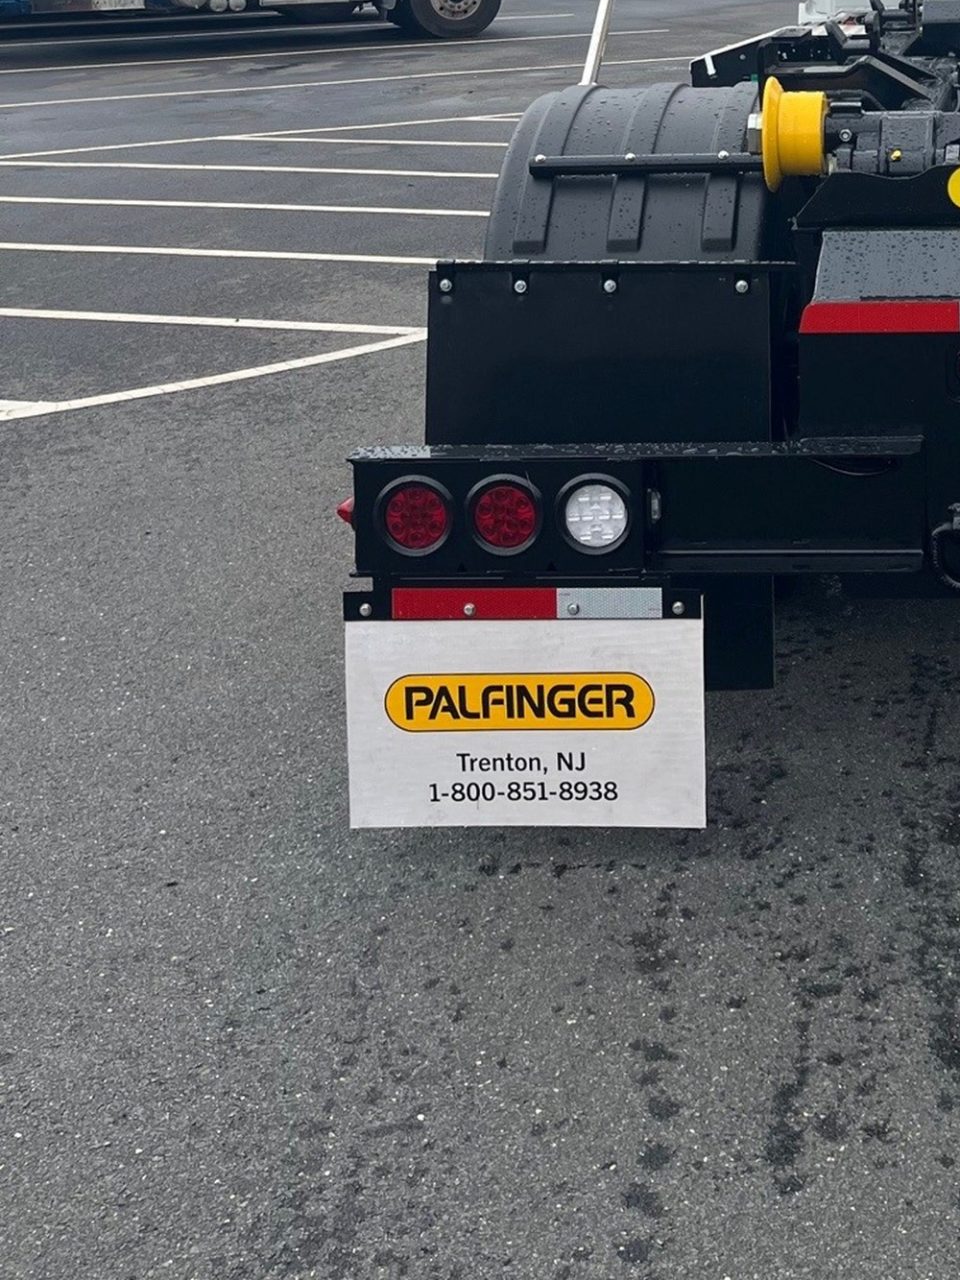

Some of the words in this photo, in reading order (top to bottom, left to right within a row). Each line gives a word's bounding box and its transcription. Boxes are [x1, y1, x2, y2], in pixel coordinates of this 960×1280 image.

[404, 683, 636, 721] PALFINGER
[456, 752, 548, 775] Trenton,
[556, 751, 586, 772] NJ
[429, 781, 618, 803] 1-800-851-8938
